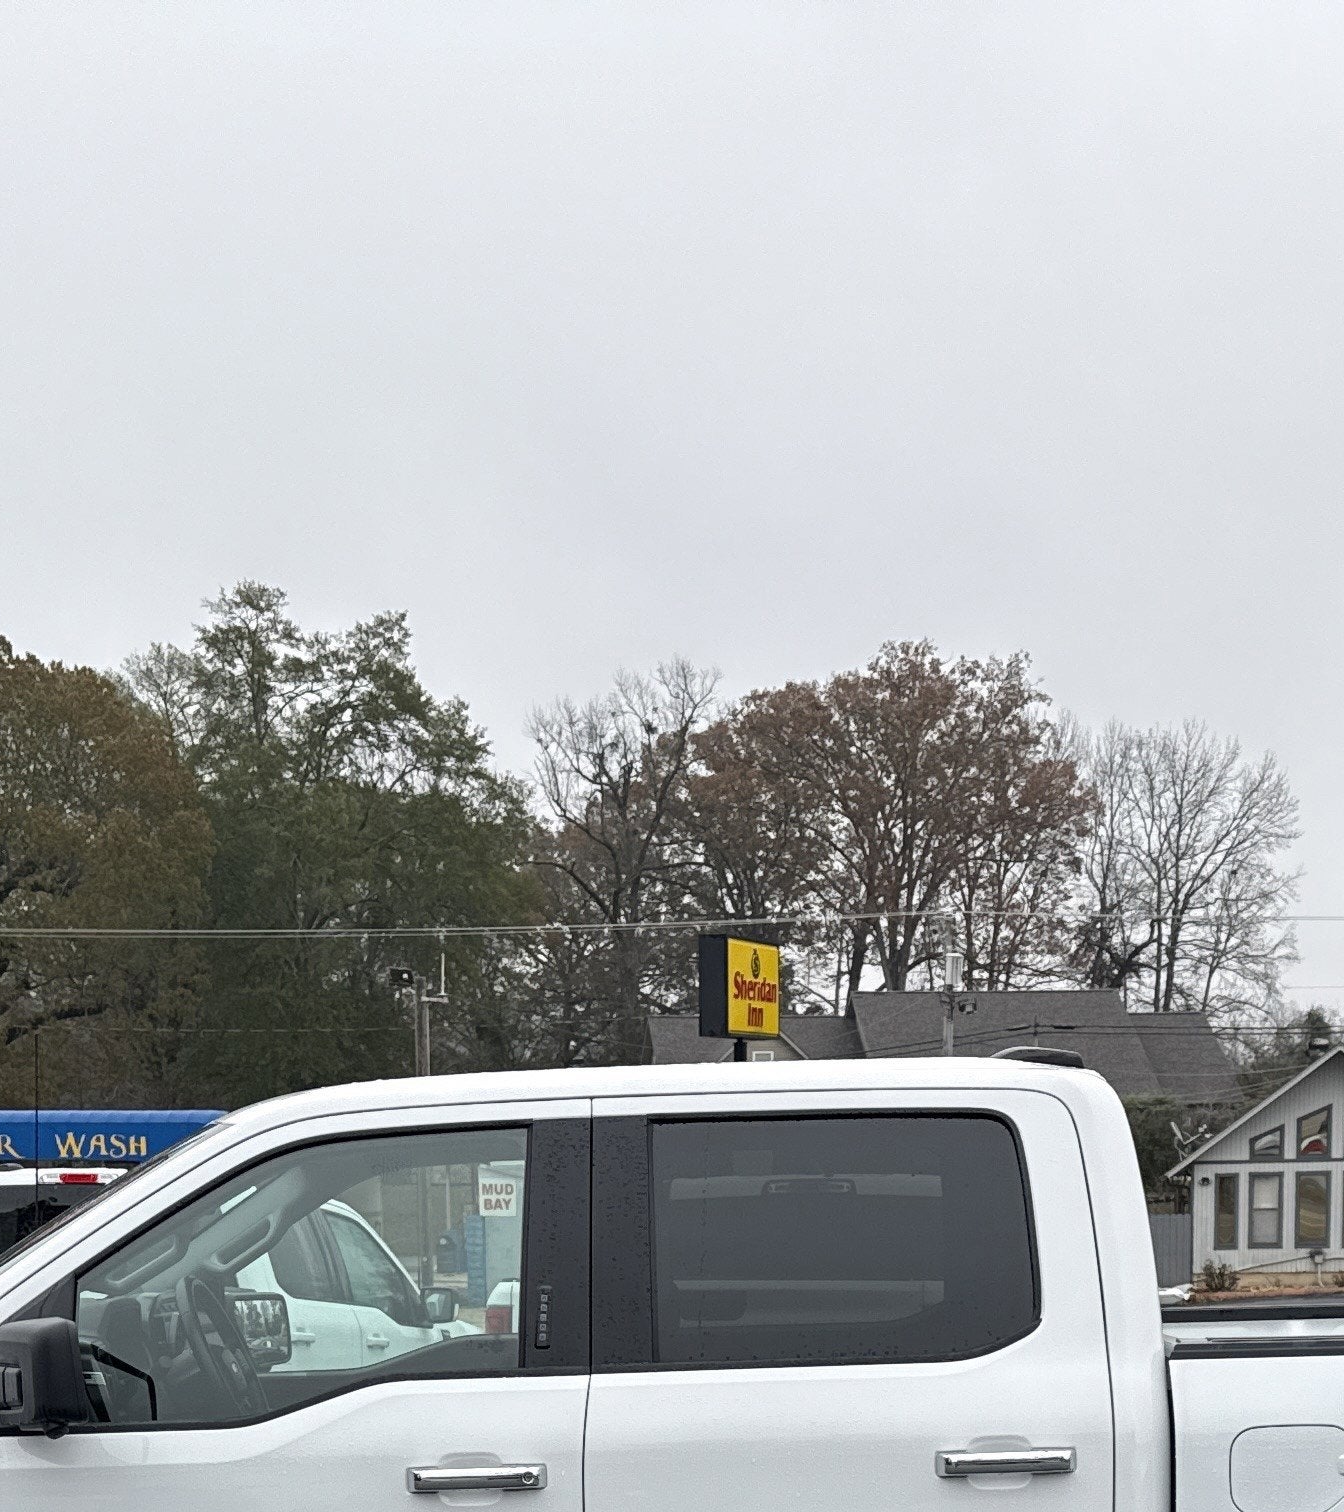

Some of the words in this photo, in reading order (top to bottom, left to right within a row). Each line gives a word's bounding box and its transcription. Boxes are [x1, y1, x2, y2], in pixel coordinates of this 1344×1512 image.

[733, 971, 777, 1003] Sheridan
[748, 1003, 764, 1028] Inn
[55, 1131, 148, 1158] WASH
[481, 1183, 514, 1196] MUD
[484, 1198, 512, 1210] BAY
